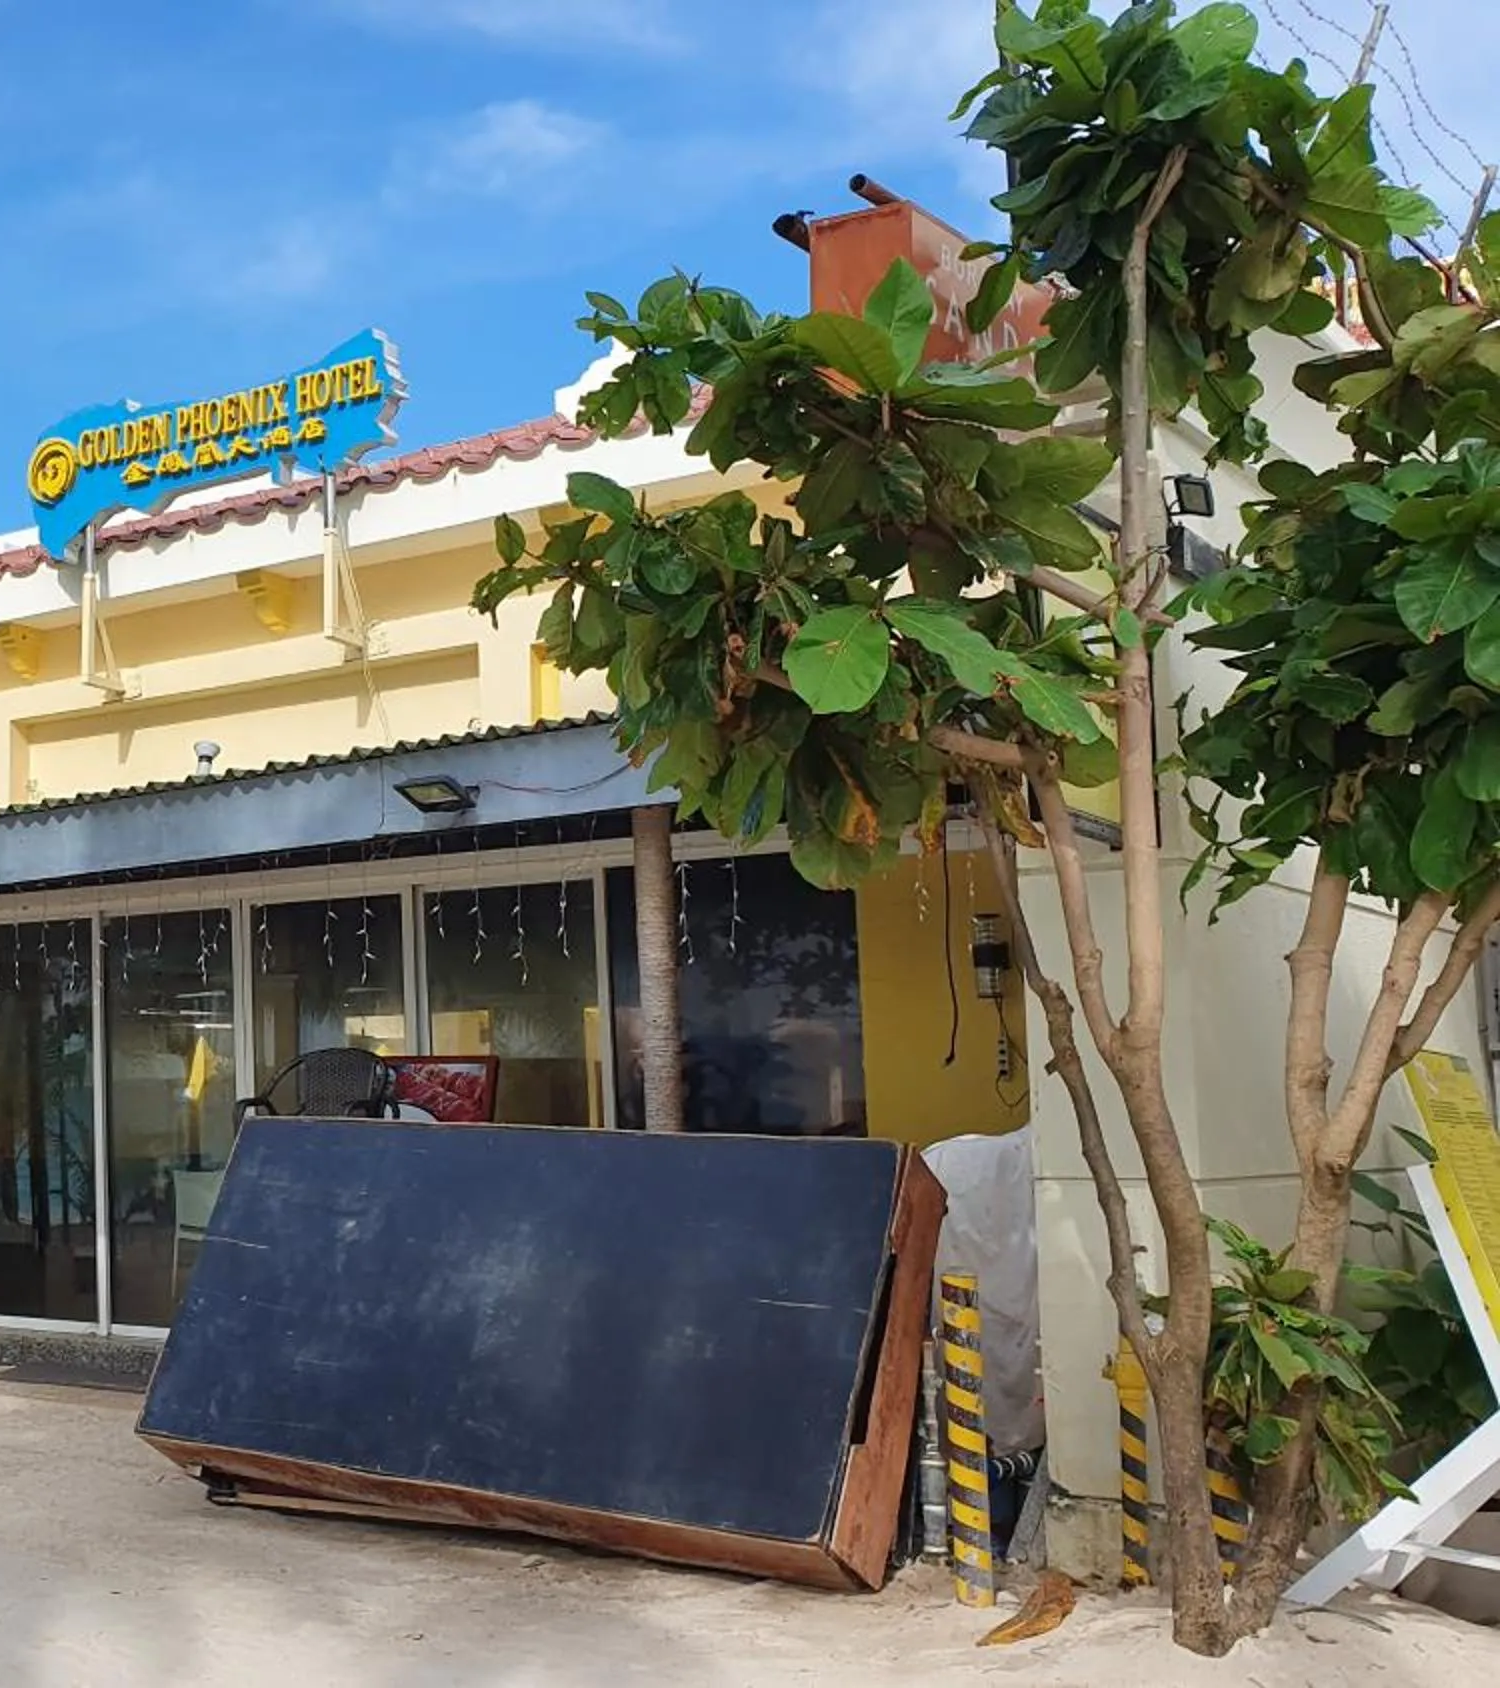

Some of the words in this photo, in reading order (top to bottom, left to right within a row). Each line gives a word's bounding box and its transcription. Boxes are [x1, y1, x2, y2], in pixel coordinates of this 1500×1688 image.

[78, 412, 172, 468] GOLDEN
[176, 381, 289, 442] PHOENIX
[294, 355, 384, 414] HOTEL
